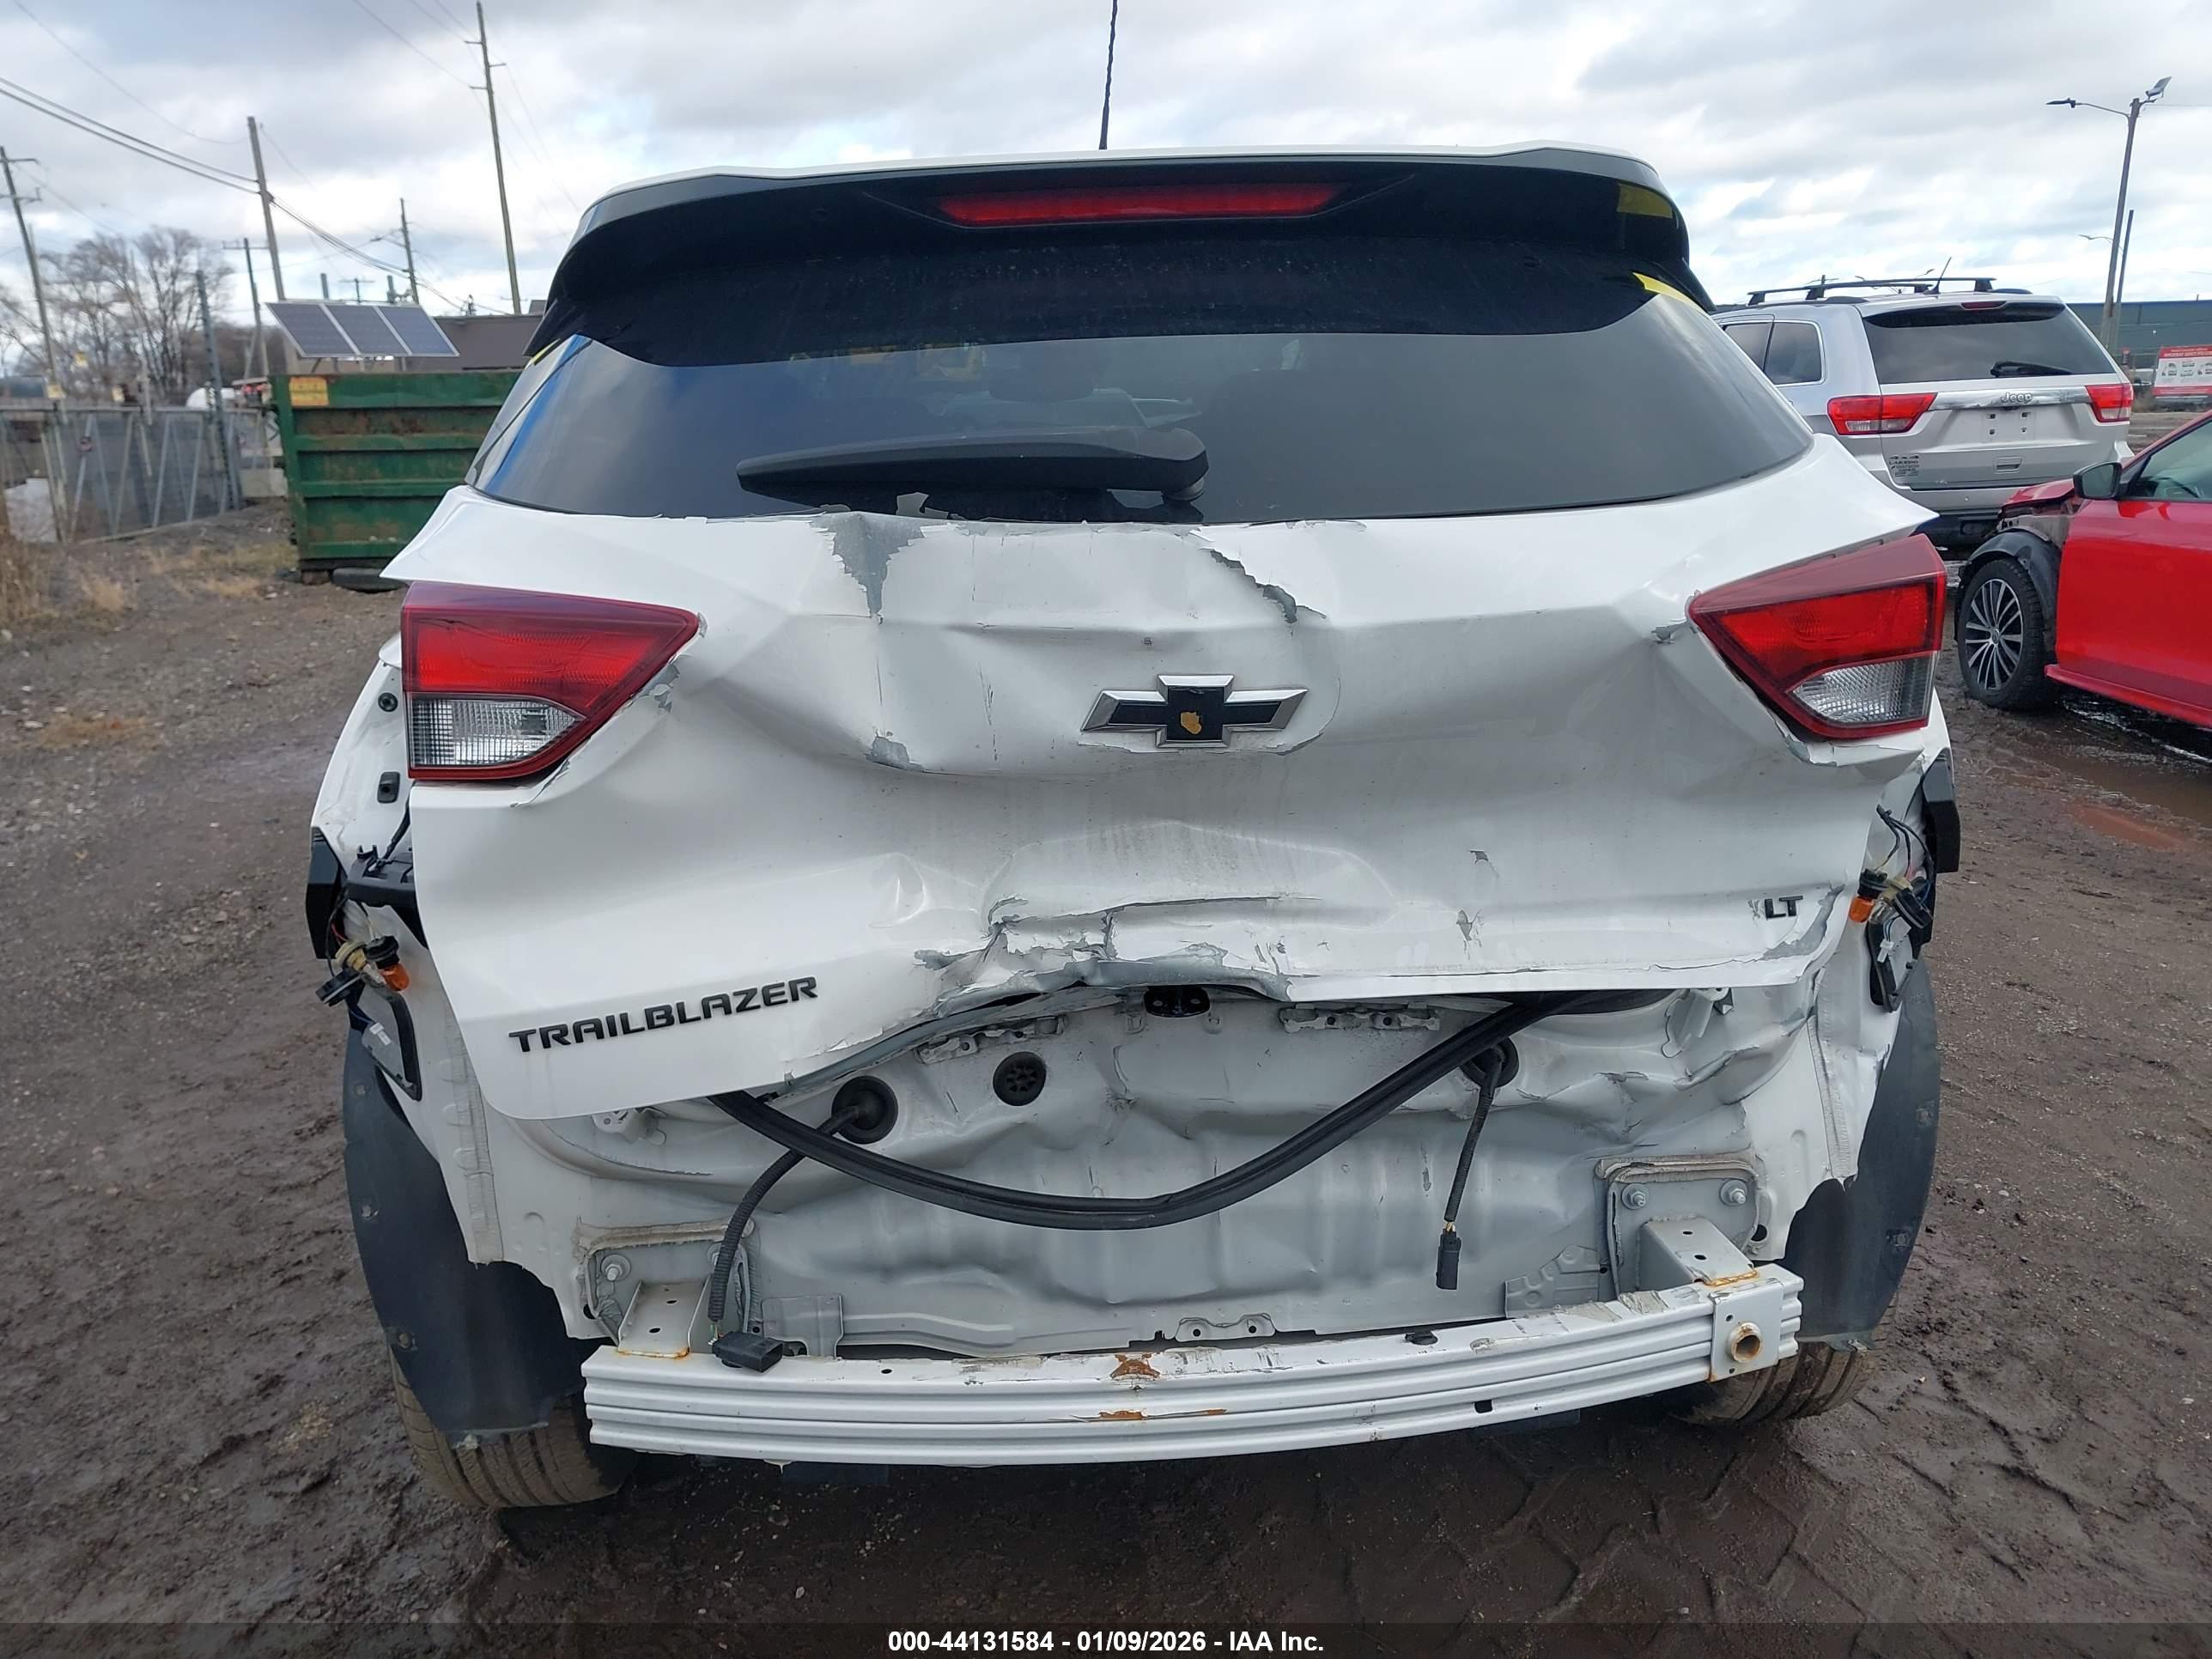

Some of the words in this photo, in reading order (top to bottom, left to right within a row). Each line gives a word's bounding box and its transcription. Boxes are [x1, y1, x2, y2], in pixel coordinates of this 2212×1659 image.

[2001, 392, 2033, 404] Jeep
[1765, 896, 1803, 920] LT
[508, 976, 818, 1053] TRAILBLAZER
